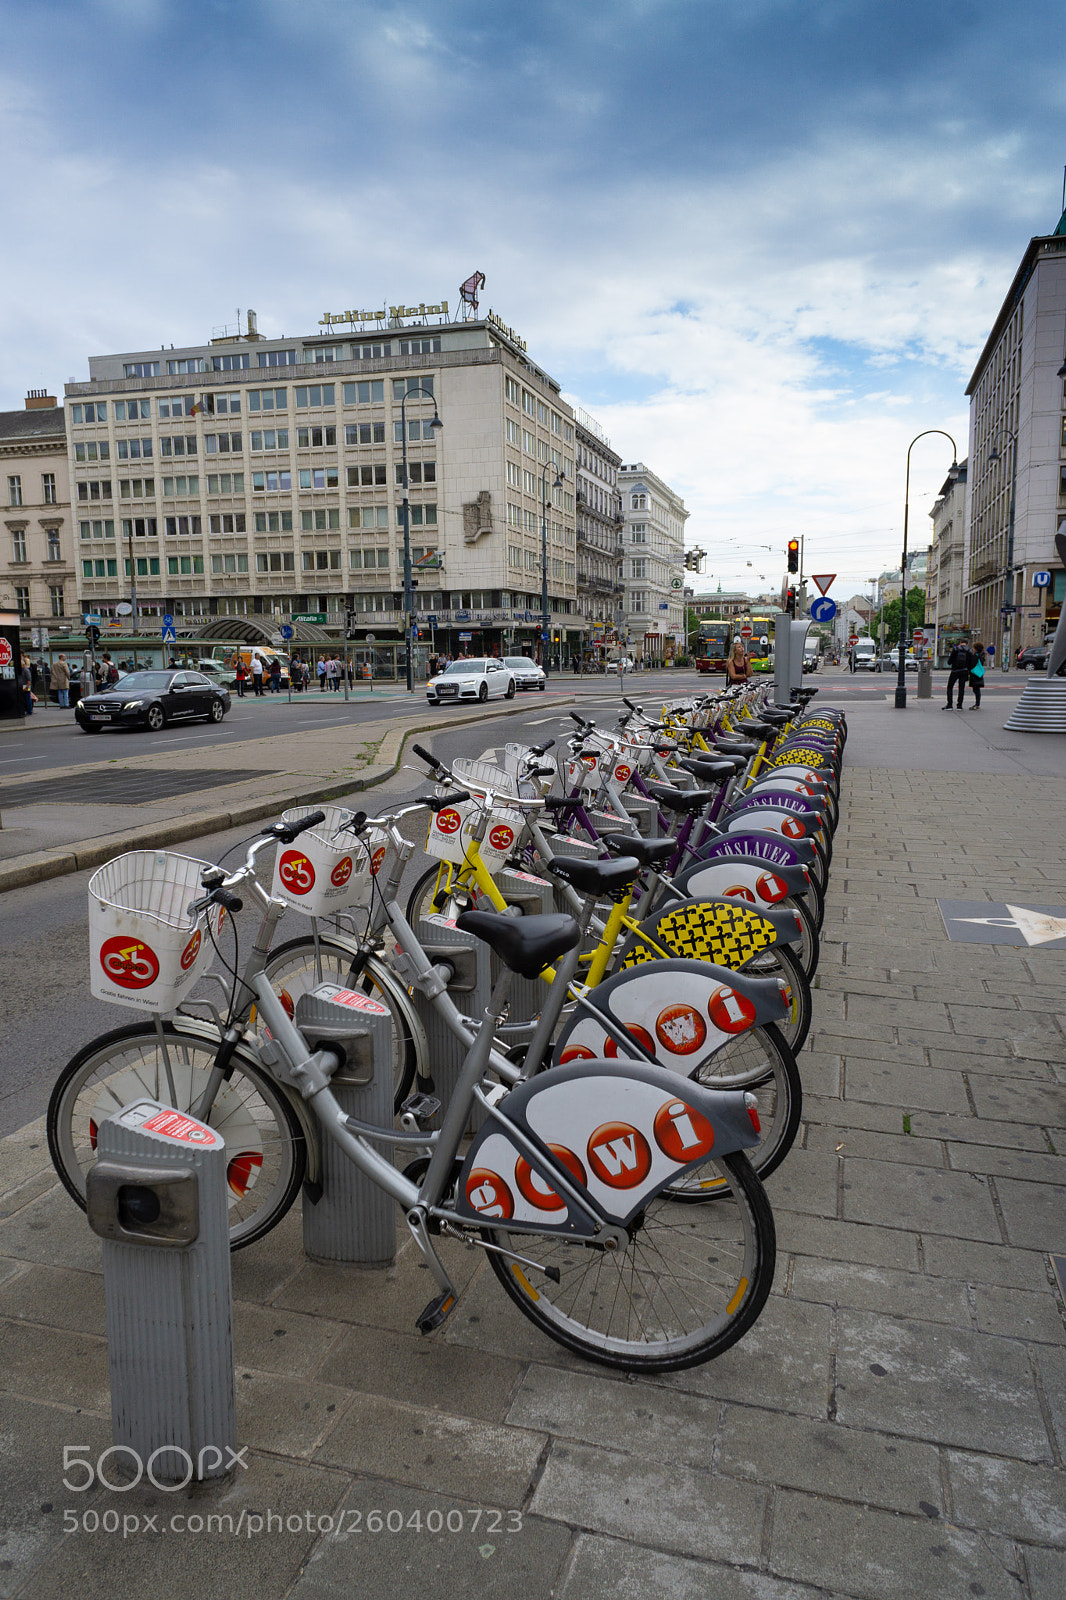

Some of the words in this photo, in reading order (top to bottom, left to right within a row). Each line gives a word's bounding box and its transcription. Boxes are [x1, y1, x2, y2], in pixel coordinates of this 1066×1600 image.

[318, 309, 385, 325] Julius
[389, 301, 448, 318] Meinl
[1036, 574, 1048, 585] U
[112, 961, 144, 971] citybike
